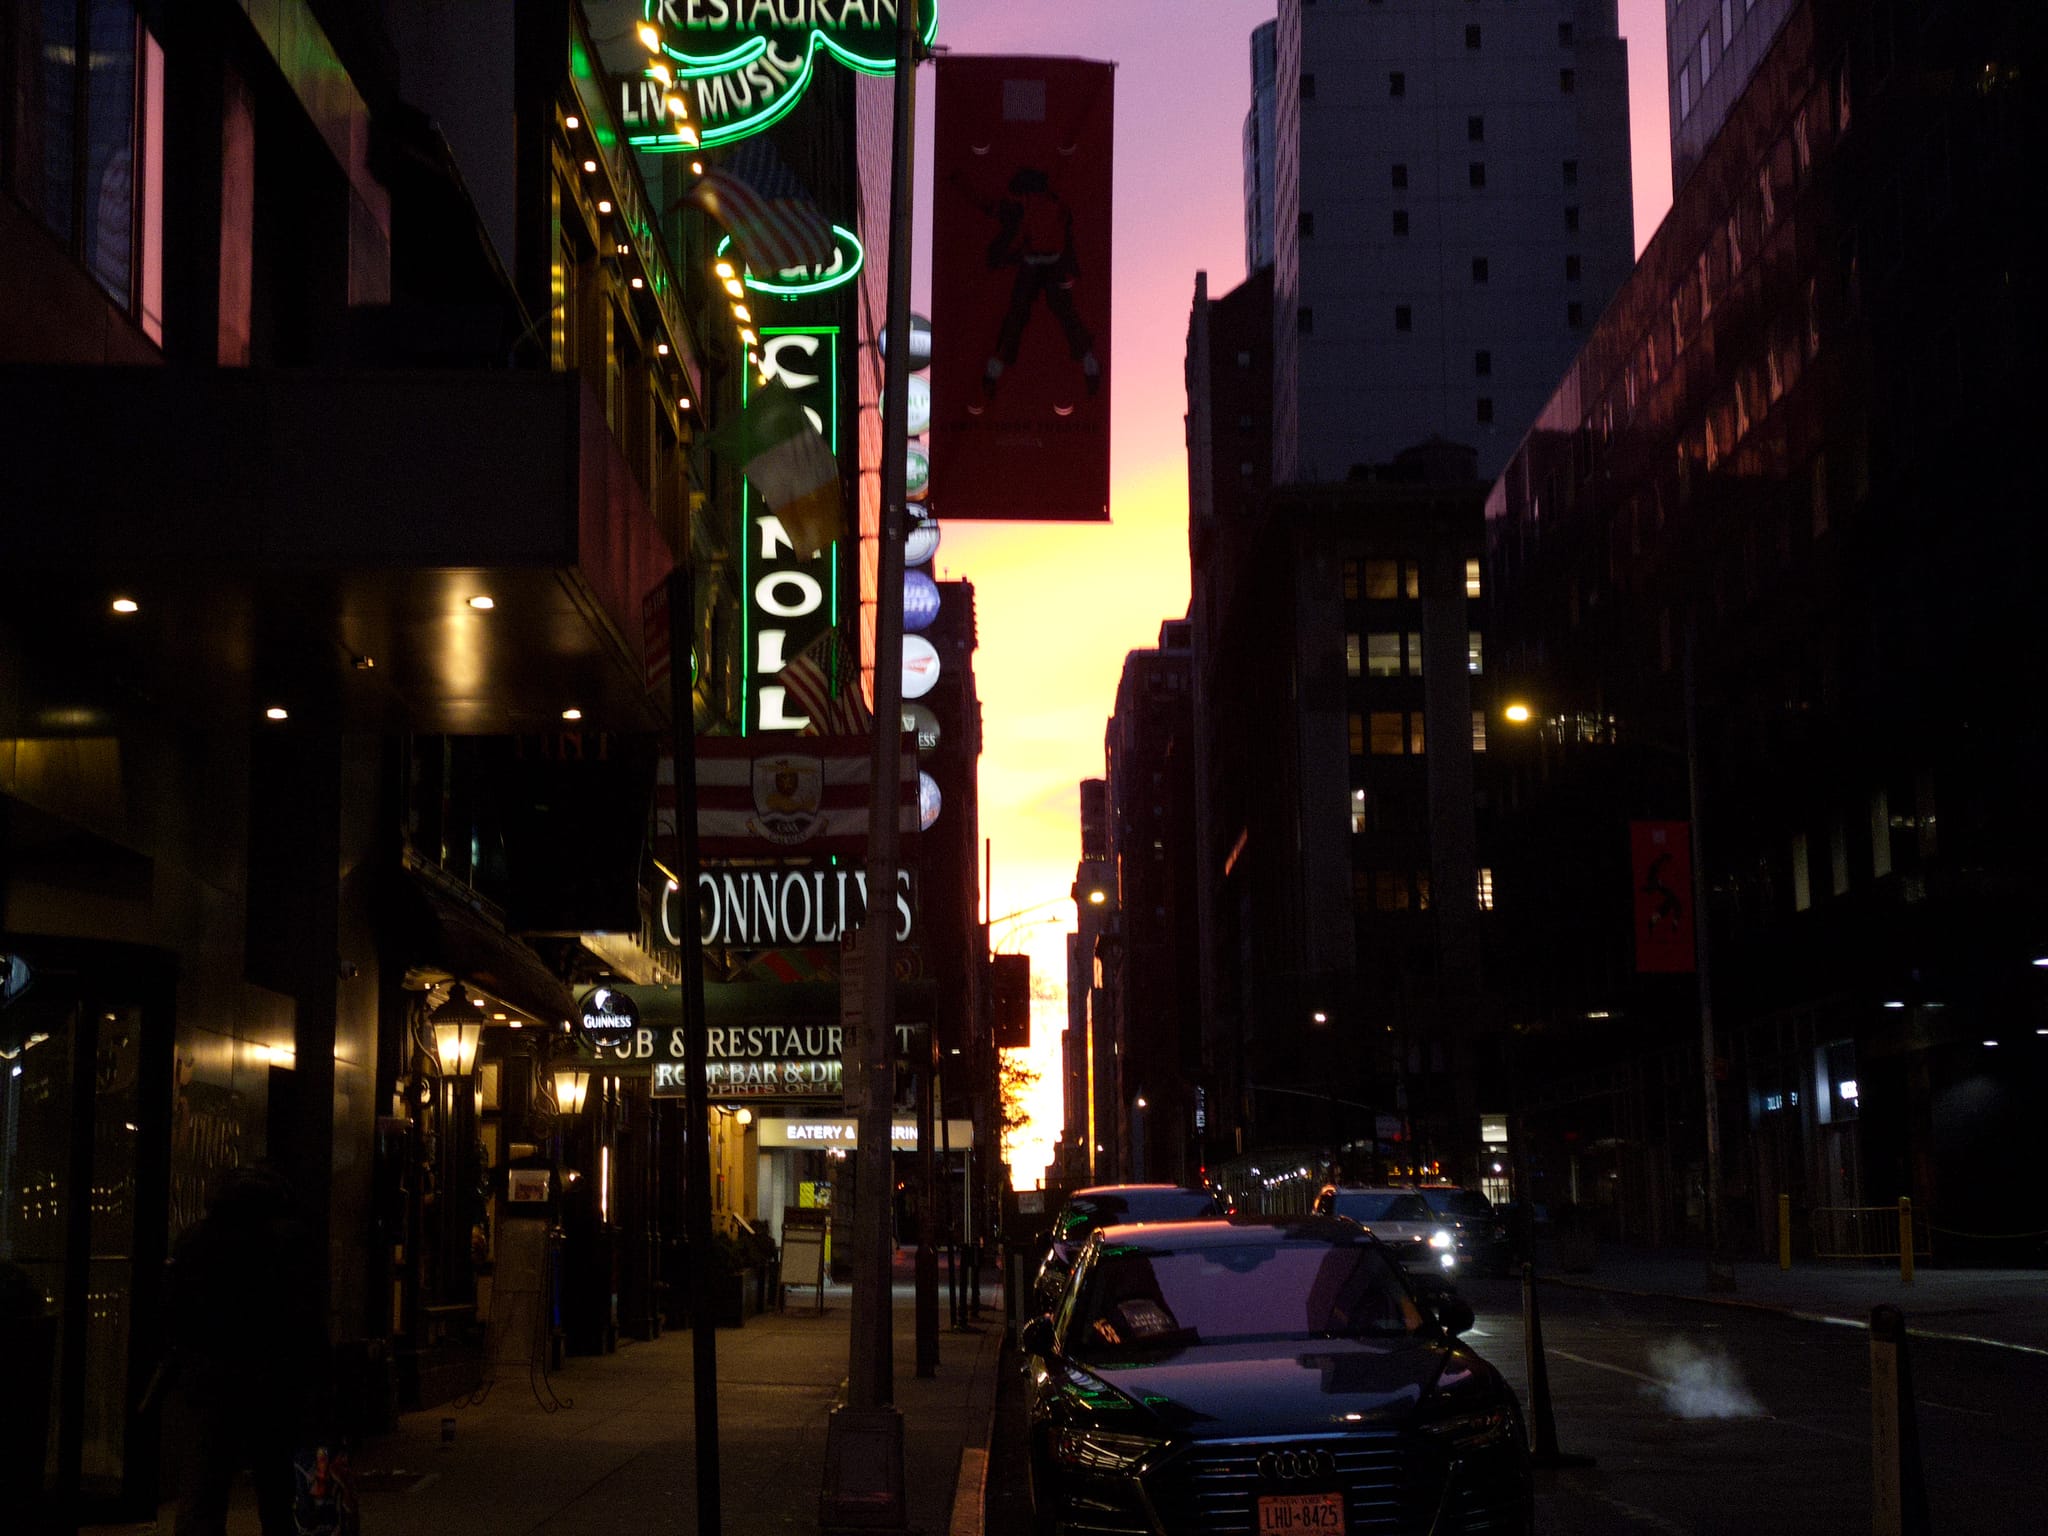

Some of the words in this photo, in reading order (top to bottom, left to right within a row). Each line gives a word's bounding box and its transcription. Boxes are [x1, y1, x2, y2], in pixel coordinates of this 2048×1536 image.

[696, 38, 805, 123] MUSIC
[583, 1013, 633, 1029] GUINNESS
[729, 1061, 779, 1085] BAR
[784, 1061, 805, 1083] &
[787, 1125, 842, 1139] EATERY
[845, 1125, 856, 1139] &
